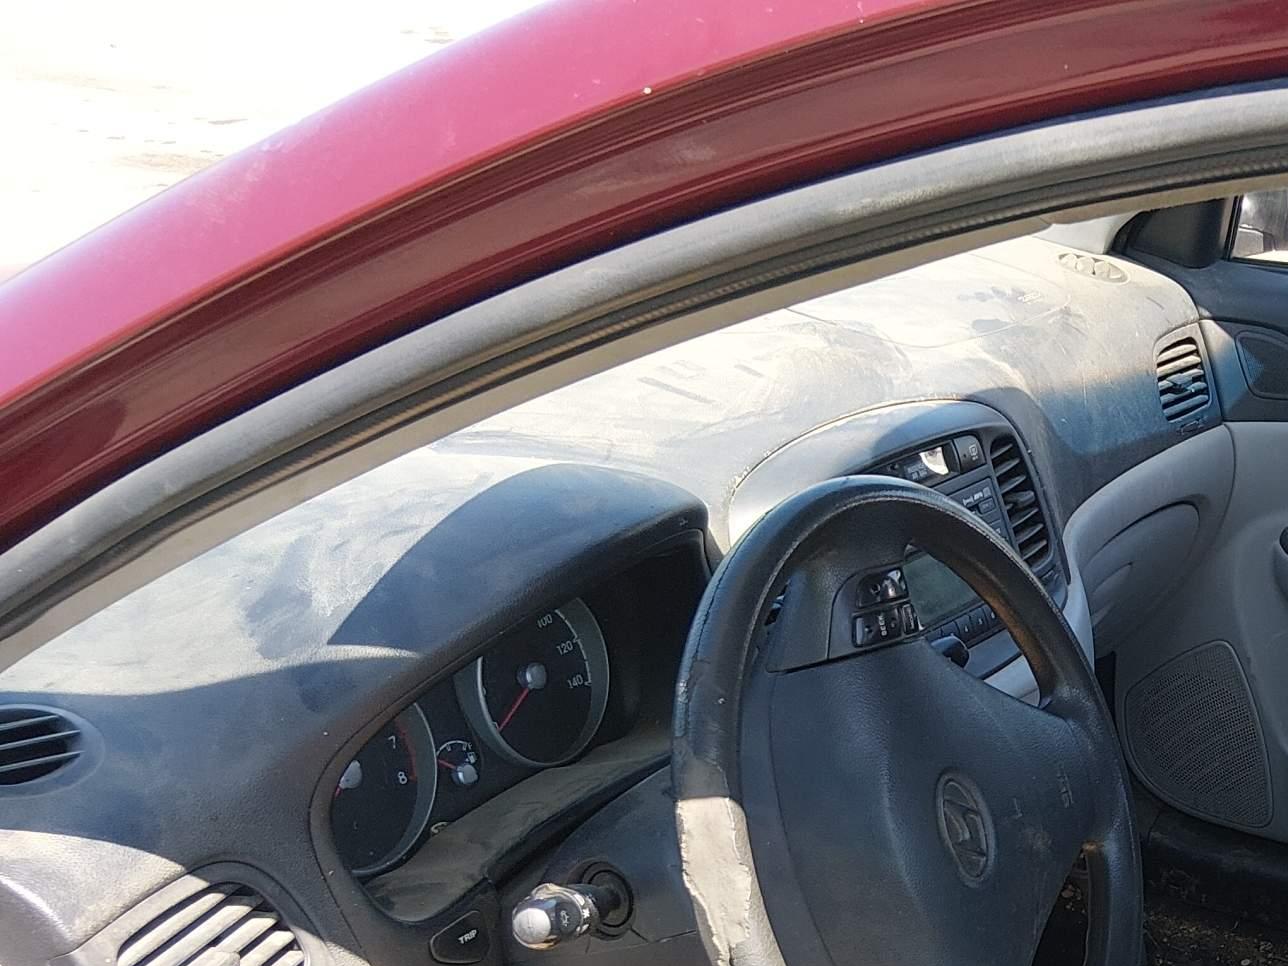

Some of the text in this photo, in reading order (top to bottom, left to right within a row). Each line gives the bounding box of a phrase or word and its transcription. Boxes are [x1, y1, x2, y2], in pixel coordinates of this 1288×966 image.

[536, 613, 554, 629] 100
[555, 640, 574, 656] 120
[566, 673, 585, 690] 140
[387, 735, 397, 750] 7
[396, 770, 409, 785] 8
[457, 929, 478, 945] TRIP
